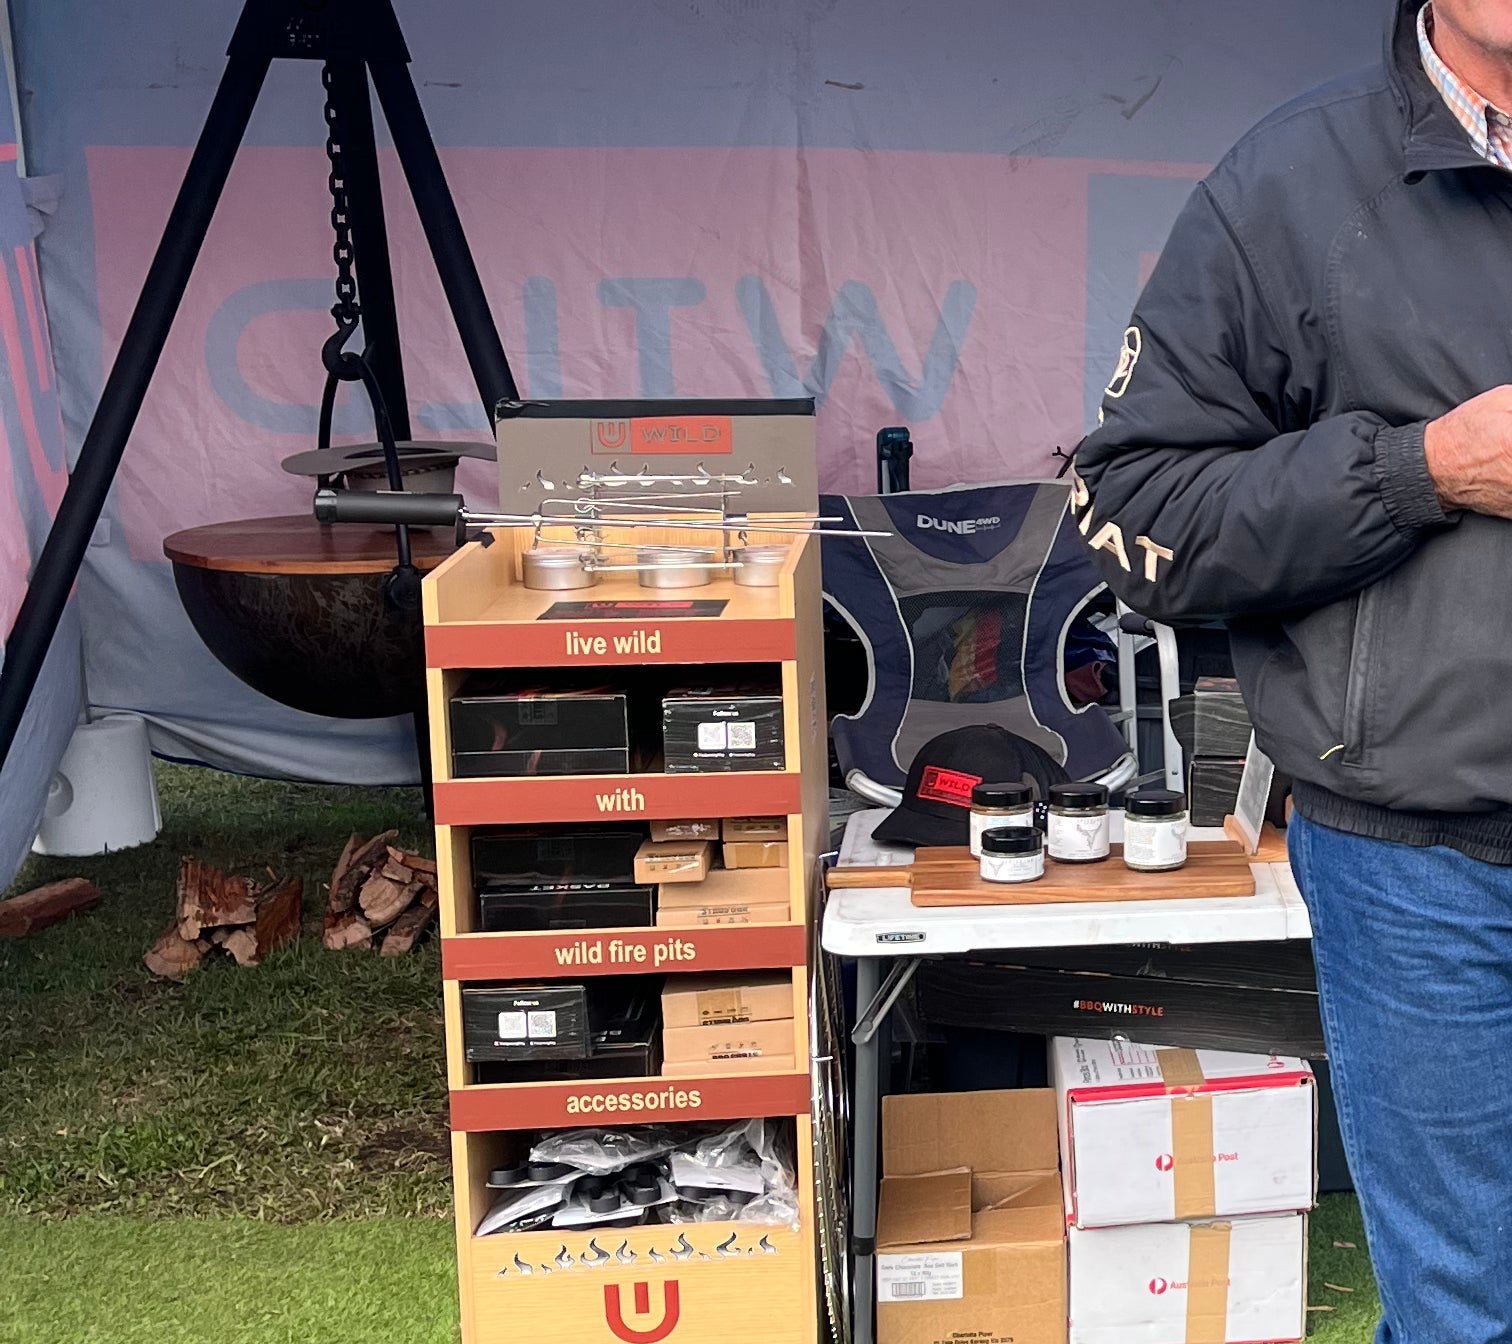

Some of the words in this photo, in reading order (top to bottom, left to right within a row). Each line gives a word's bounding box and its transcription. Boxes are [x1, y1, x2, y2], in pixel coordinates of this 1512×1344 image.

[641, 424, 722, 444] WILD
[917, 514, 976, 535] DUNE
[565, 631, 607, 655] live
[613, 629, 662, 654] wild
[596, 788, 645, 812] with
[555, 941, 604, 967] wild
[609, 940, 647, 963] fire
[654, 939, 697, 966] pits
[1073, 999, 1164, 1018] #BBQWITHSTYLE
[566, 1087, 702, 1114] accessories
[1218, 1153, 1239, 1161] Post
